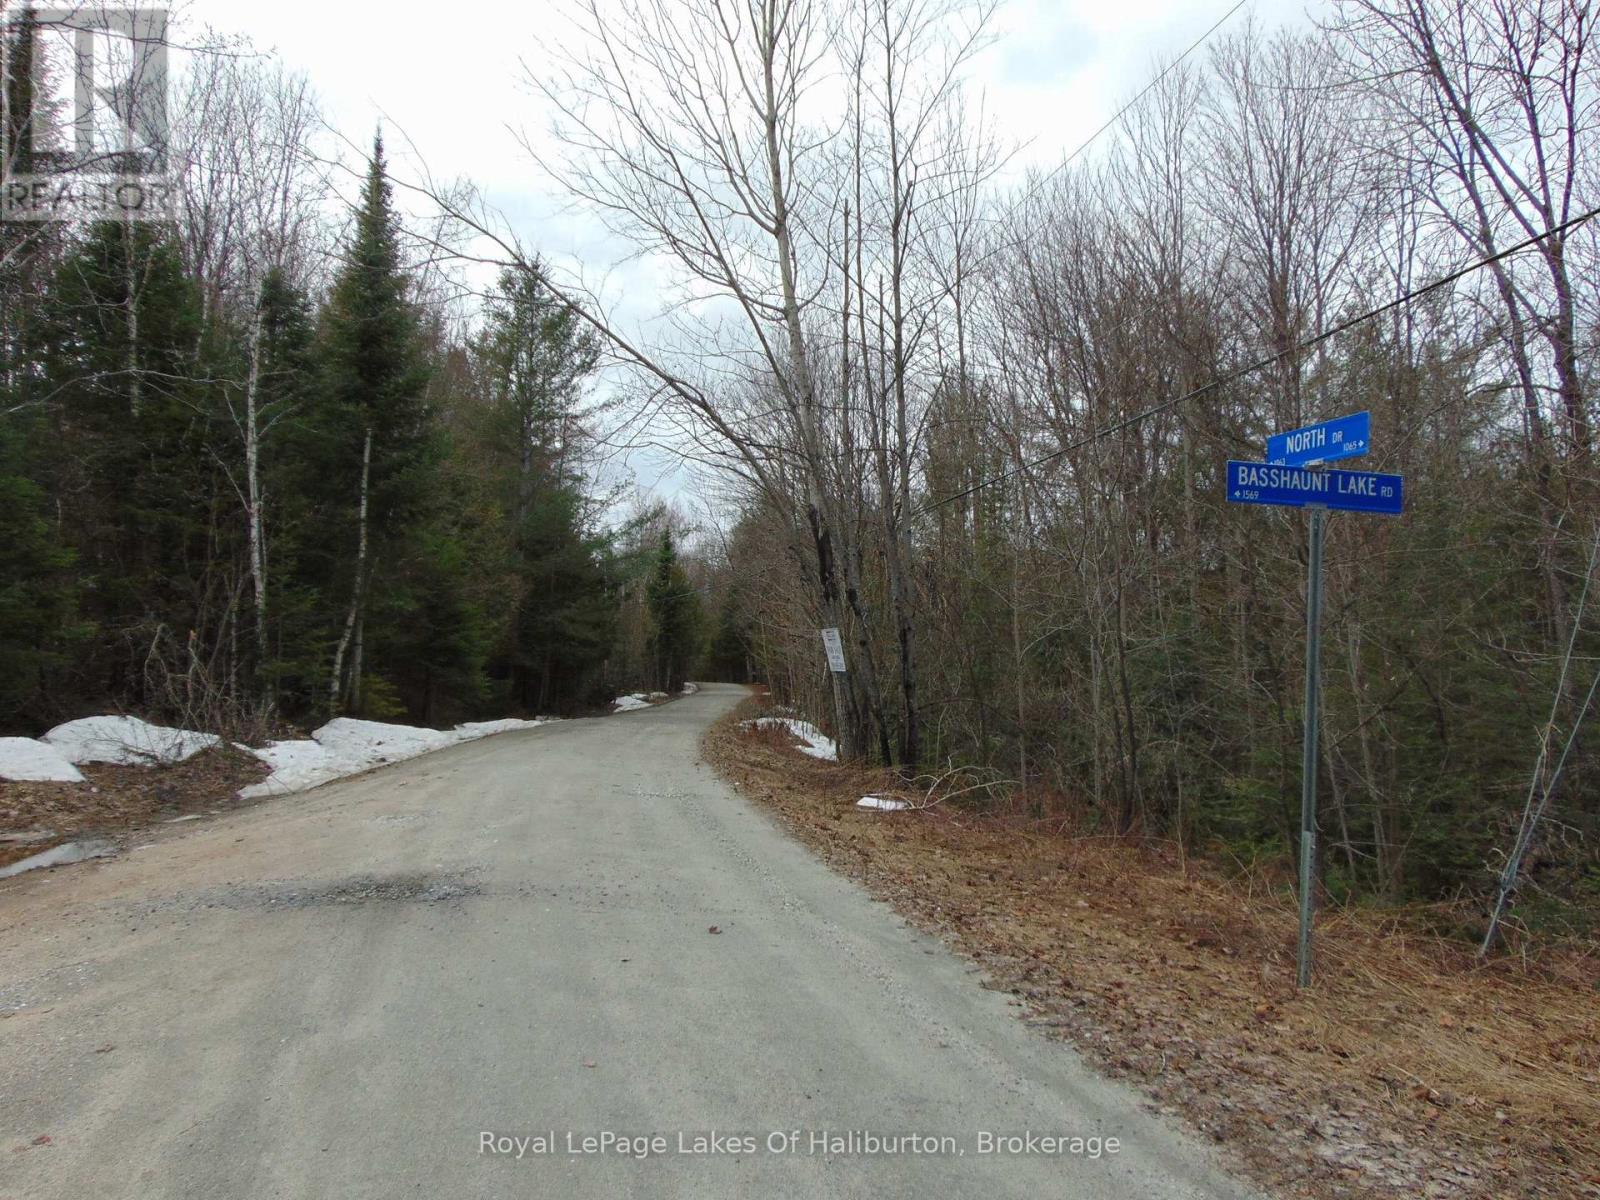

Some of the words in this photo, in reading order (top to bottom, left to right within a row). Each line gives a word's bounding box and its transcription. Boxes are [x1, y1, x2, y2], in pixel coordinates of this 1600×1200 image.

[1286, 427, 1326, 454] NORTH
[1332, 431, 1343, 444] DR
[1343, 440, 1357, 451] 1065
[1238, 466, 1331, 492] BASSHAUNT
[1338, 474, 1377, 496] LAKE
[1380, 486, 1393, 498] RD
[1242, 490, 1259, 500] 1569
